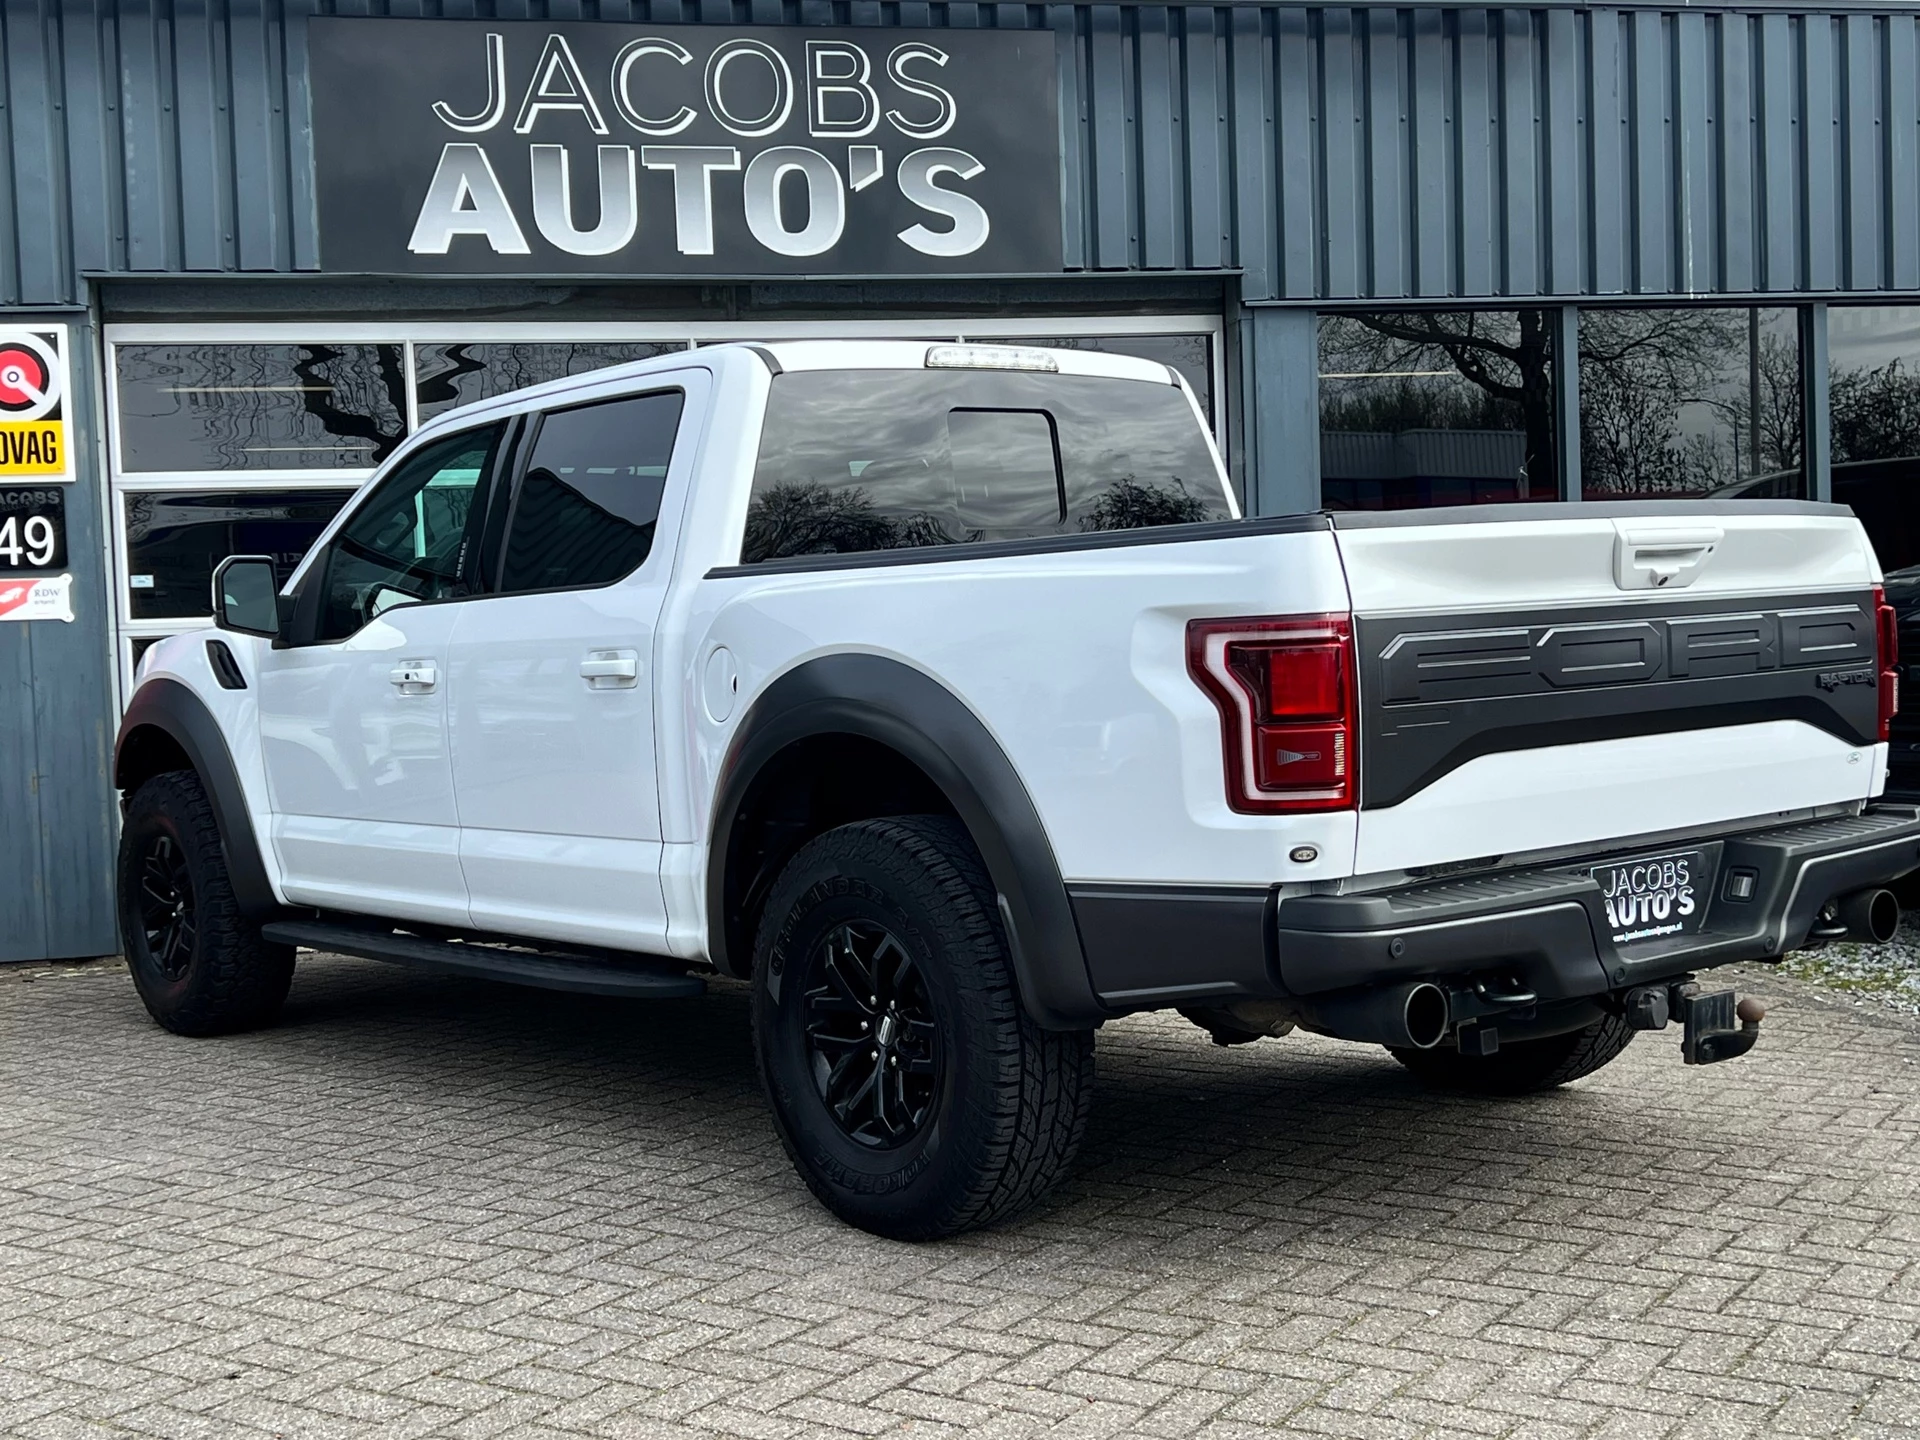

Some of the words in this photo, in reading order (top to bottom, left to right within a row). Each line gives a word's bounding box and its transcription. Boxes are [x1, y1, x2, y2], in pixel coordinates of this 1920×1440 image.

[432, 33, 957, 138] JACOBS
[407, 143, 990, 257] AUTO'S
[34, 588, 60, 598] RDW
[1379, 604, 1873, 708] FORD
[1815, 668, 1877, 693] RAPTOR
[1602, 859, 1690, 898] JACOBS
